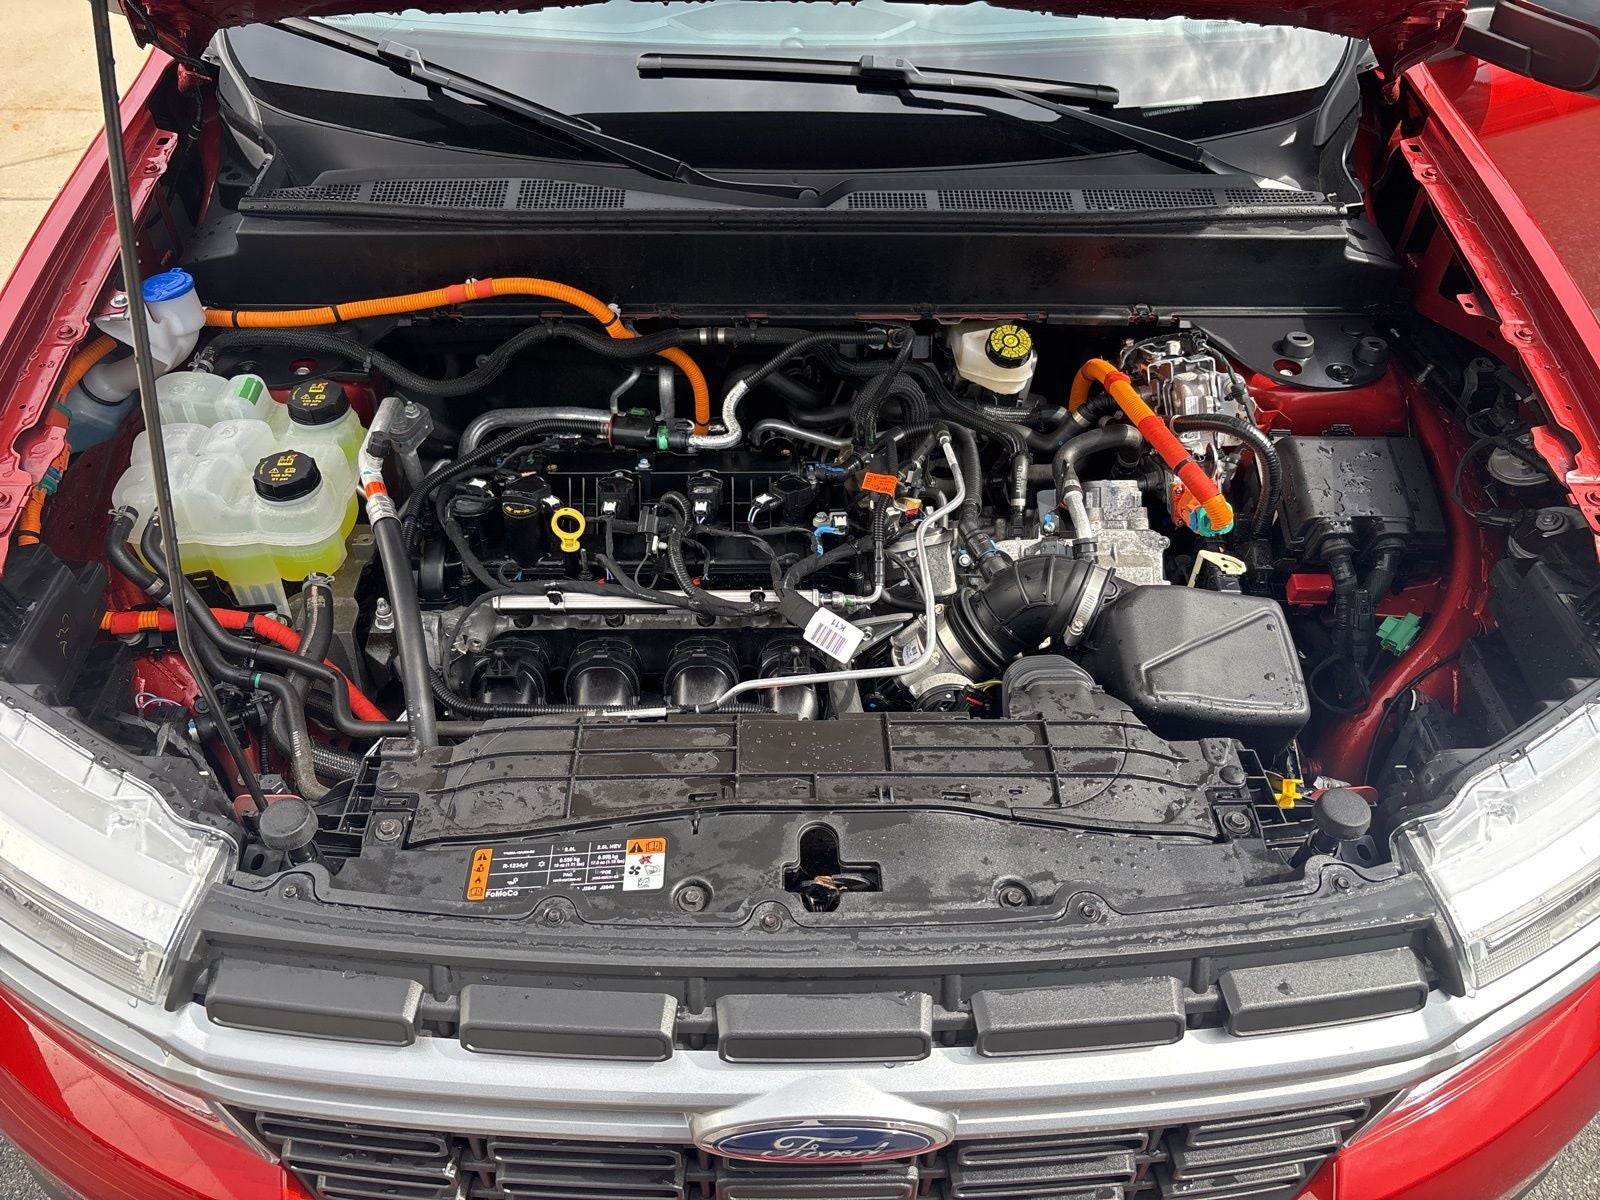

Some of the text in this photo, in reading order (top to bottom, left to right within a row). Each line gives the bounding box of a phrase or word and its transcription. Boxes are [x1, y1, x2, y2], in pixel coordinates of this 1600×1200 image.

[830, 618, 847, 632] K11
[485, 890, 519, 898] FoMoCo
[760, 1134, 891, 1160] Ford
